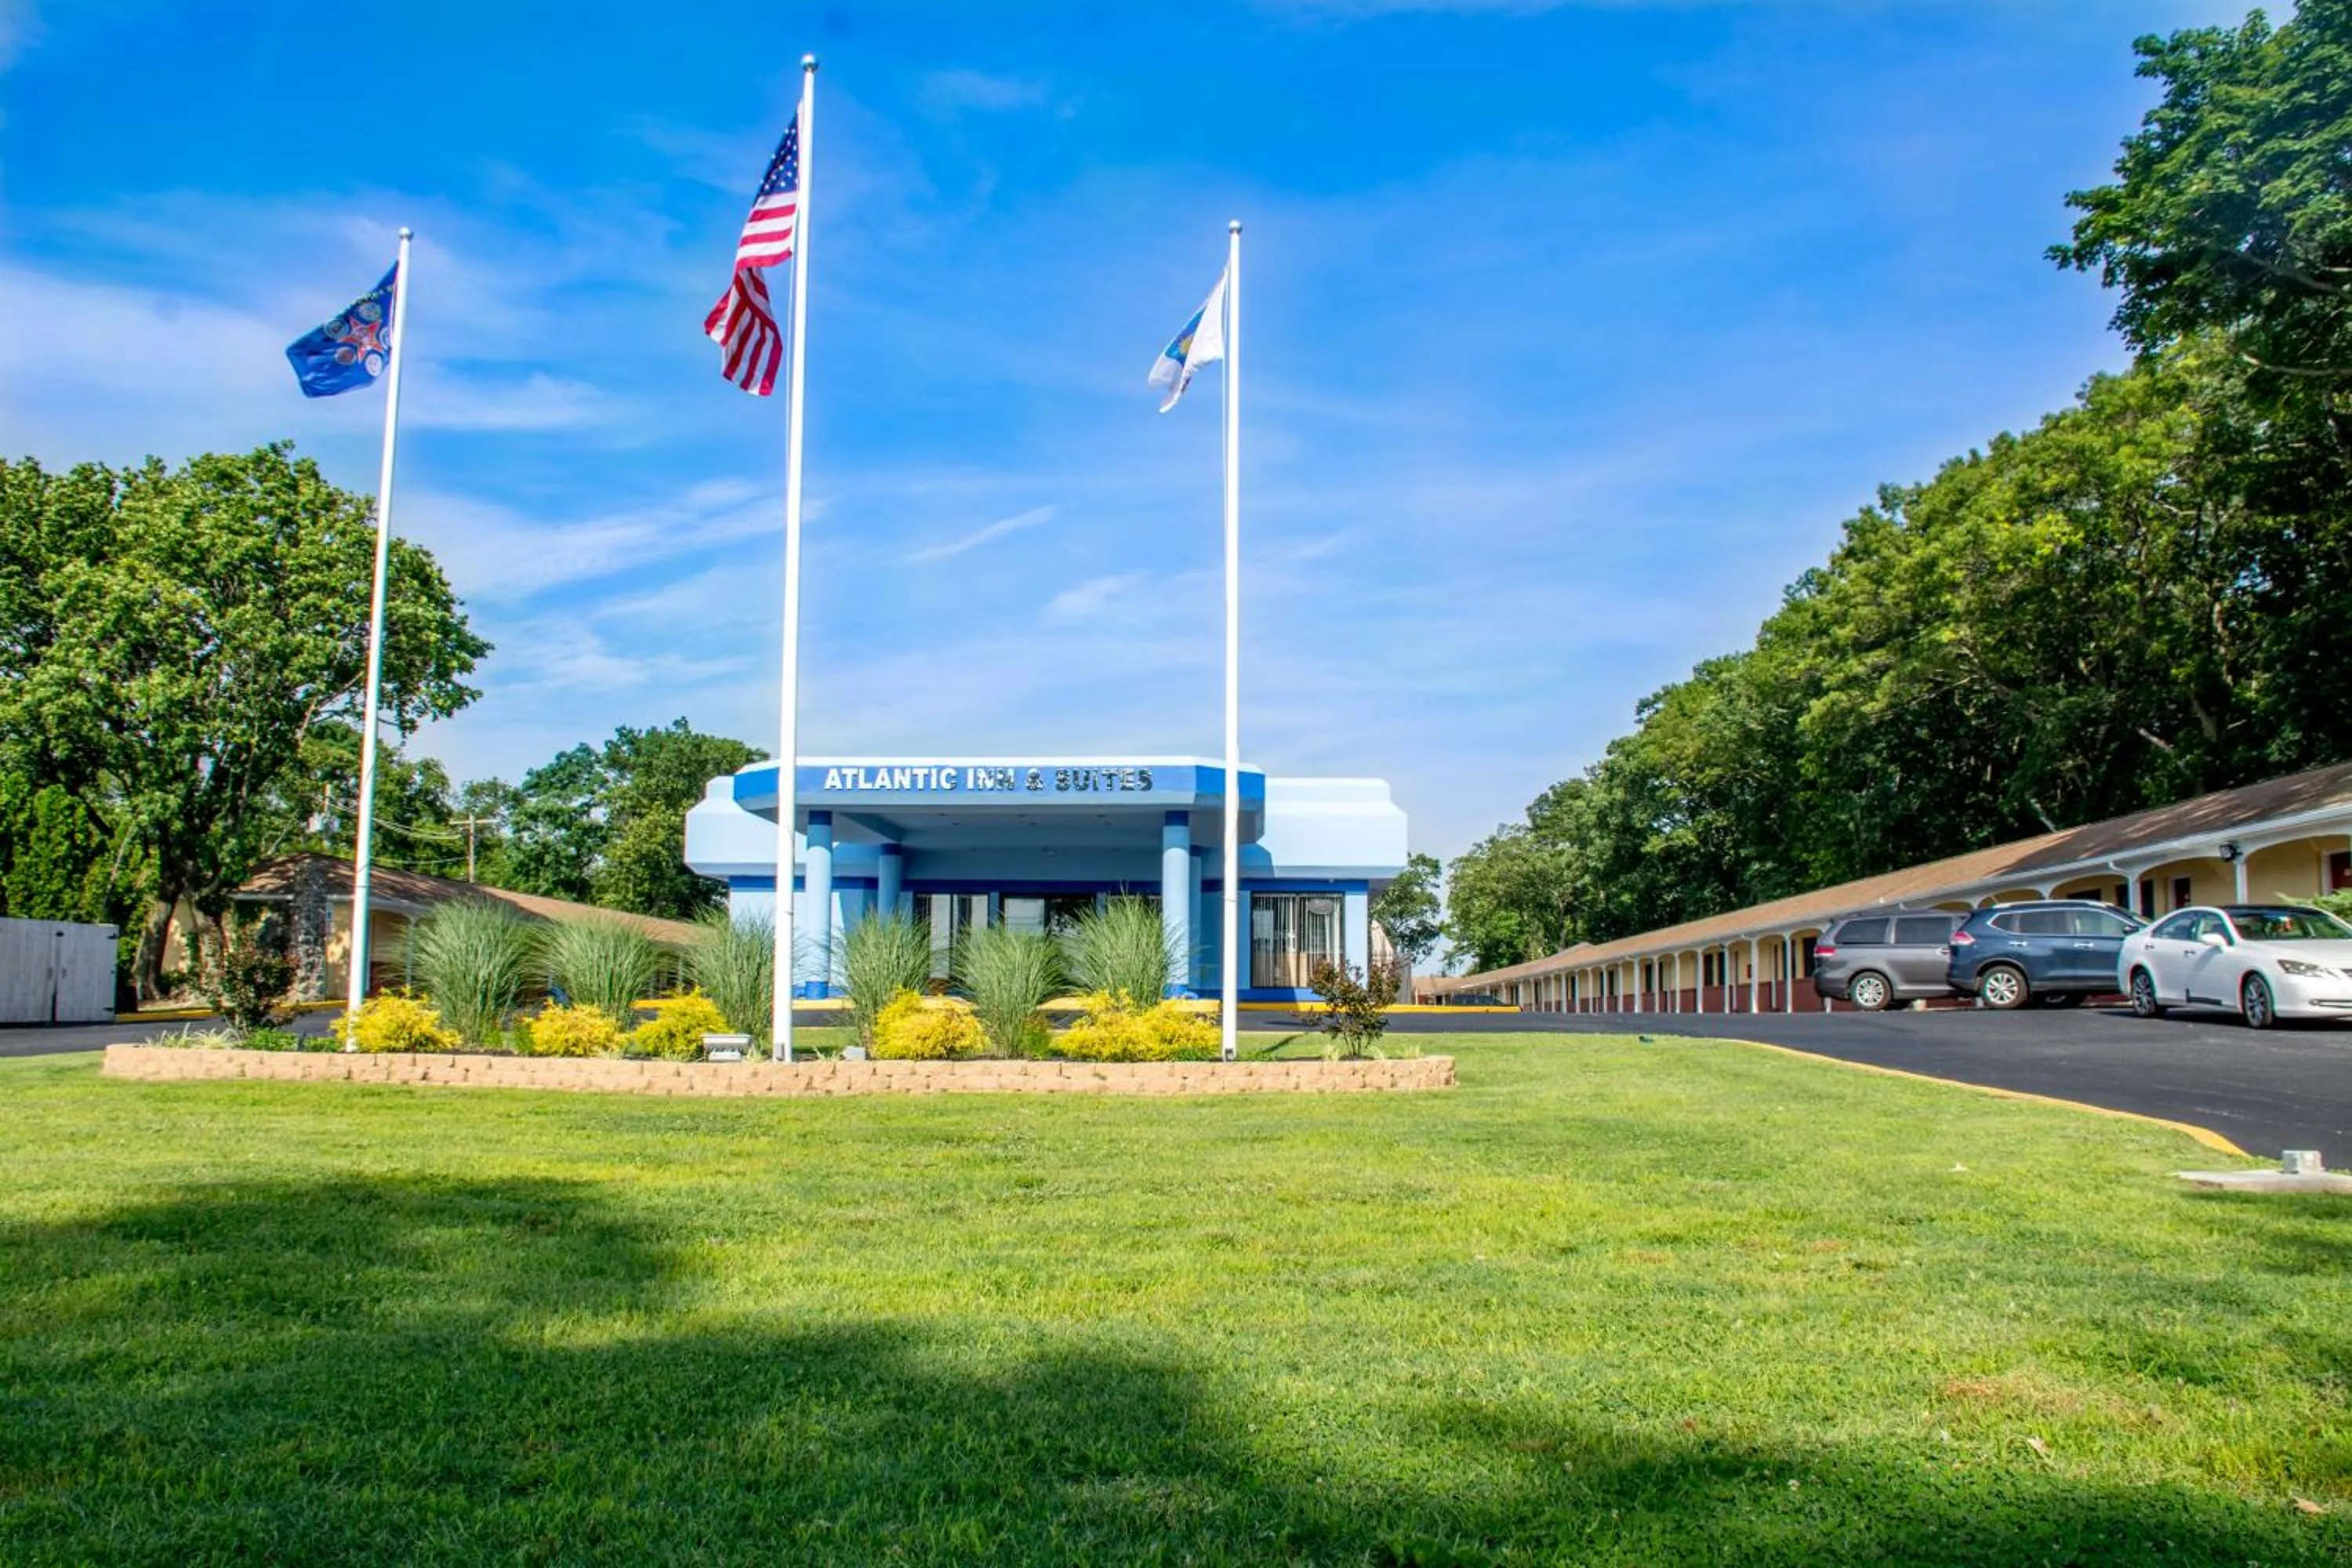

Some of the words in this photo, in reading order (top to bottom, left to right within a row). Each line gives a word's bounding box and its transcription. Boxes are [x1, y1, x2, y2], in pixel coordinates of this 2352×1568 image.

[824, 768, 957, 790] ATLANTIC
[966, 767, 1015, 790] INN
[1026, 768, 1044, 790] &
[1055, 768, 1152, 791] SUITES
